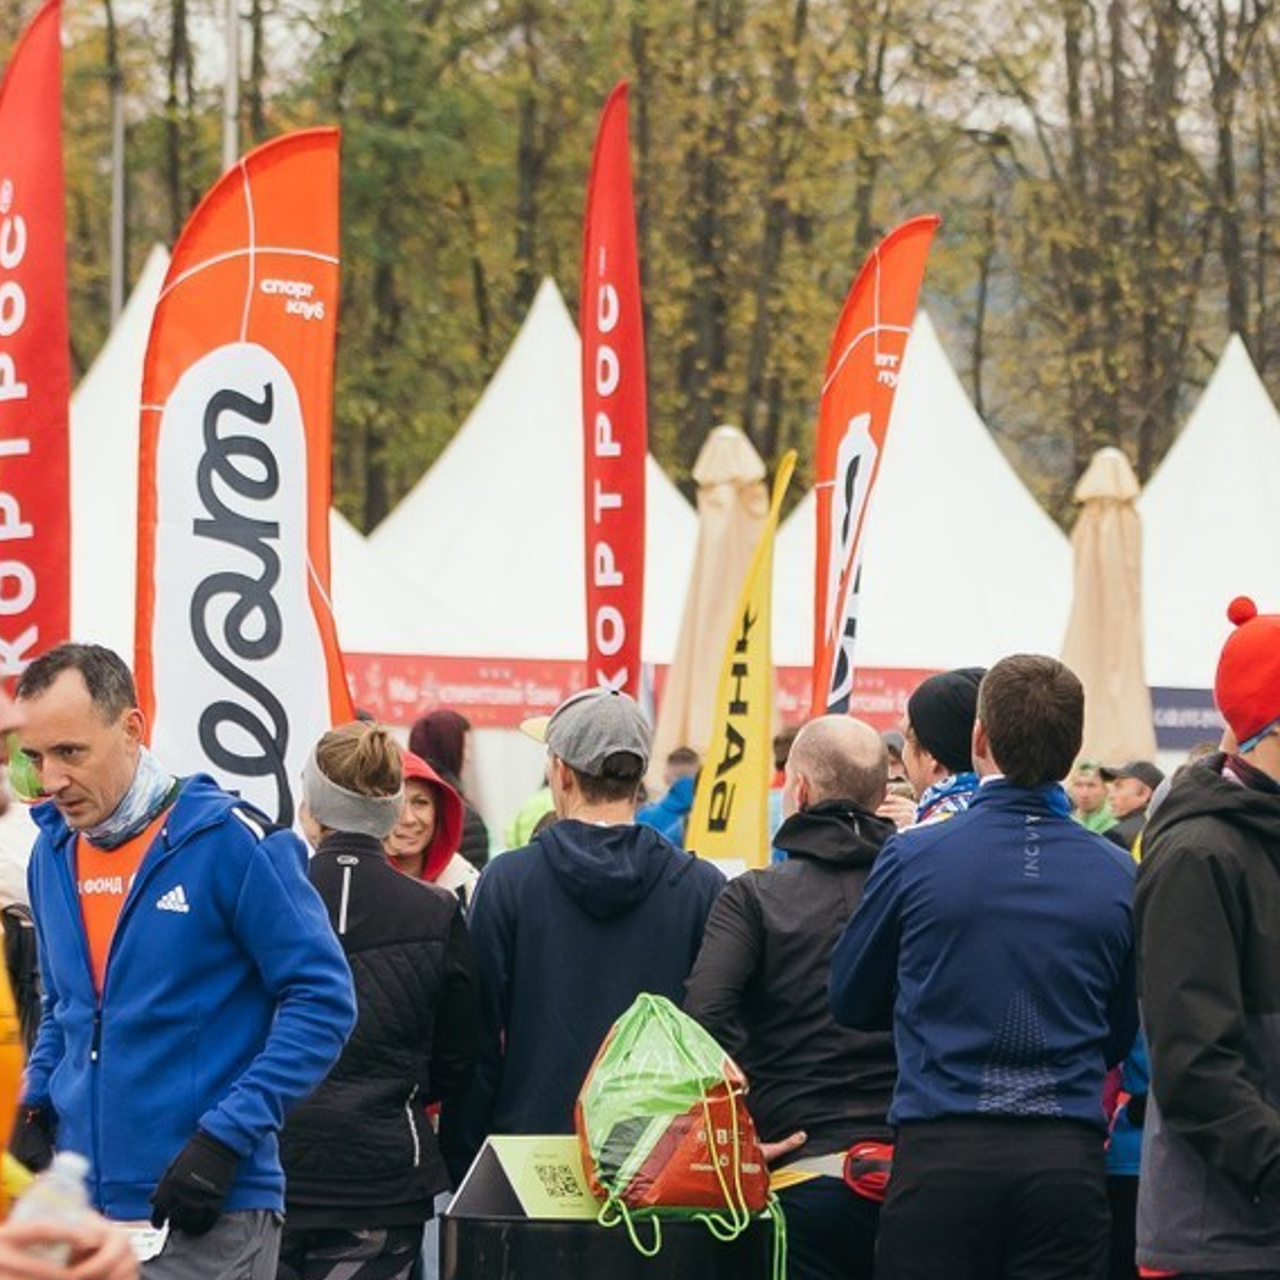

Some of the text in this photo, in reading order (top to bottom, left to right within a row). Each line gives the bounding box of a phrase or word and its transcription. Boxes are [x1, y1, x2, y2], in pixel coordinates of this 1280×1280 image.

[260, 279, 314, 299] спорт
[191, 381, 294, 830] eam
[84, 877, 122, 894] ФОНД
